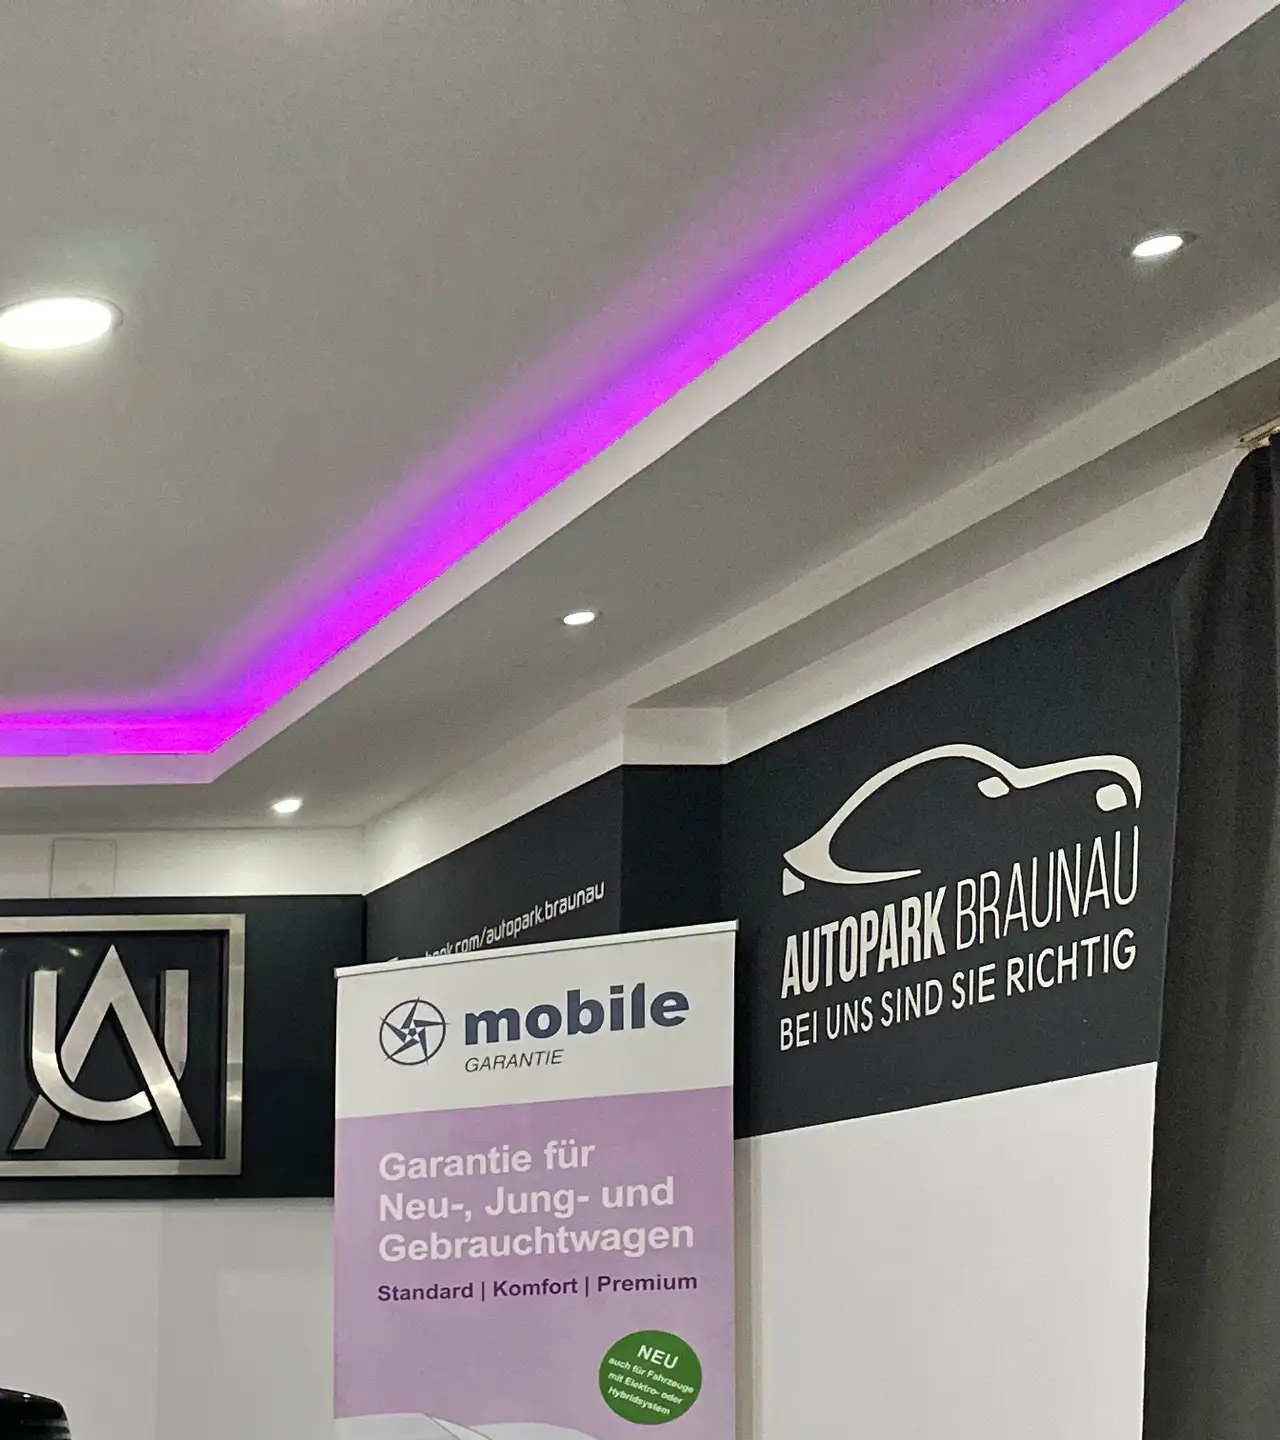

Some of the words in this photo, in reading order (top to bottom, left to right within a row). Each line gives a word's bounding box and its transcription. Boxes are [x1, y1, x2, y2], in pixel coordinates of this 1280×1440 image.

[780, 886, 947, 999] AUTOPARK
[956, 826, 1139, 950] BRAUNAU
[780, 1010, 818, 1051] BEI
[826, 997, 873, 1040] UNS
[880, 979, 943, 1027] SIND
[951, 963, 996, 1010] SIE
[1006, 928, 1136, 996] RICHTIG
[464, 982, 690, 1046] mobile
[464, 1049, 564, 1073] GARANTIE
[378, 1145, 532, 1181] Garantie
[543, 1138, 596, 1170] für
[379, 1192, 472, 1223] Neu-,
[484, 1186, 590, 1219] Jung-
[602, 1175, 674, 1208] und
[378, 1225, 694, 1262] Gebrauchtwagen
[377, 1283, 474, 1302] Standard
[493, 1278, 578, 1297] Komfort
[597, 1274, 698, 1293] Premium
[637, 1344, 679, 1369] NEU
[607, 1372, 623, 1384] mit
[624, 1376, 660, 1396] Elektro-
[661, 1391, 684, 1405] oder
[608, 1357, 631, 1371] auch
[632, 1364, 646, 1377] für
[646, 1370, 695, 1394] Fahrzeuge
[607, 1386, 671, 1416] Hybridsystem
